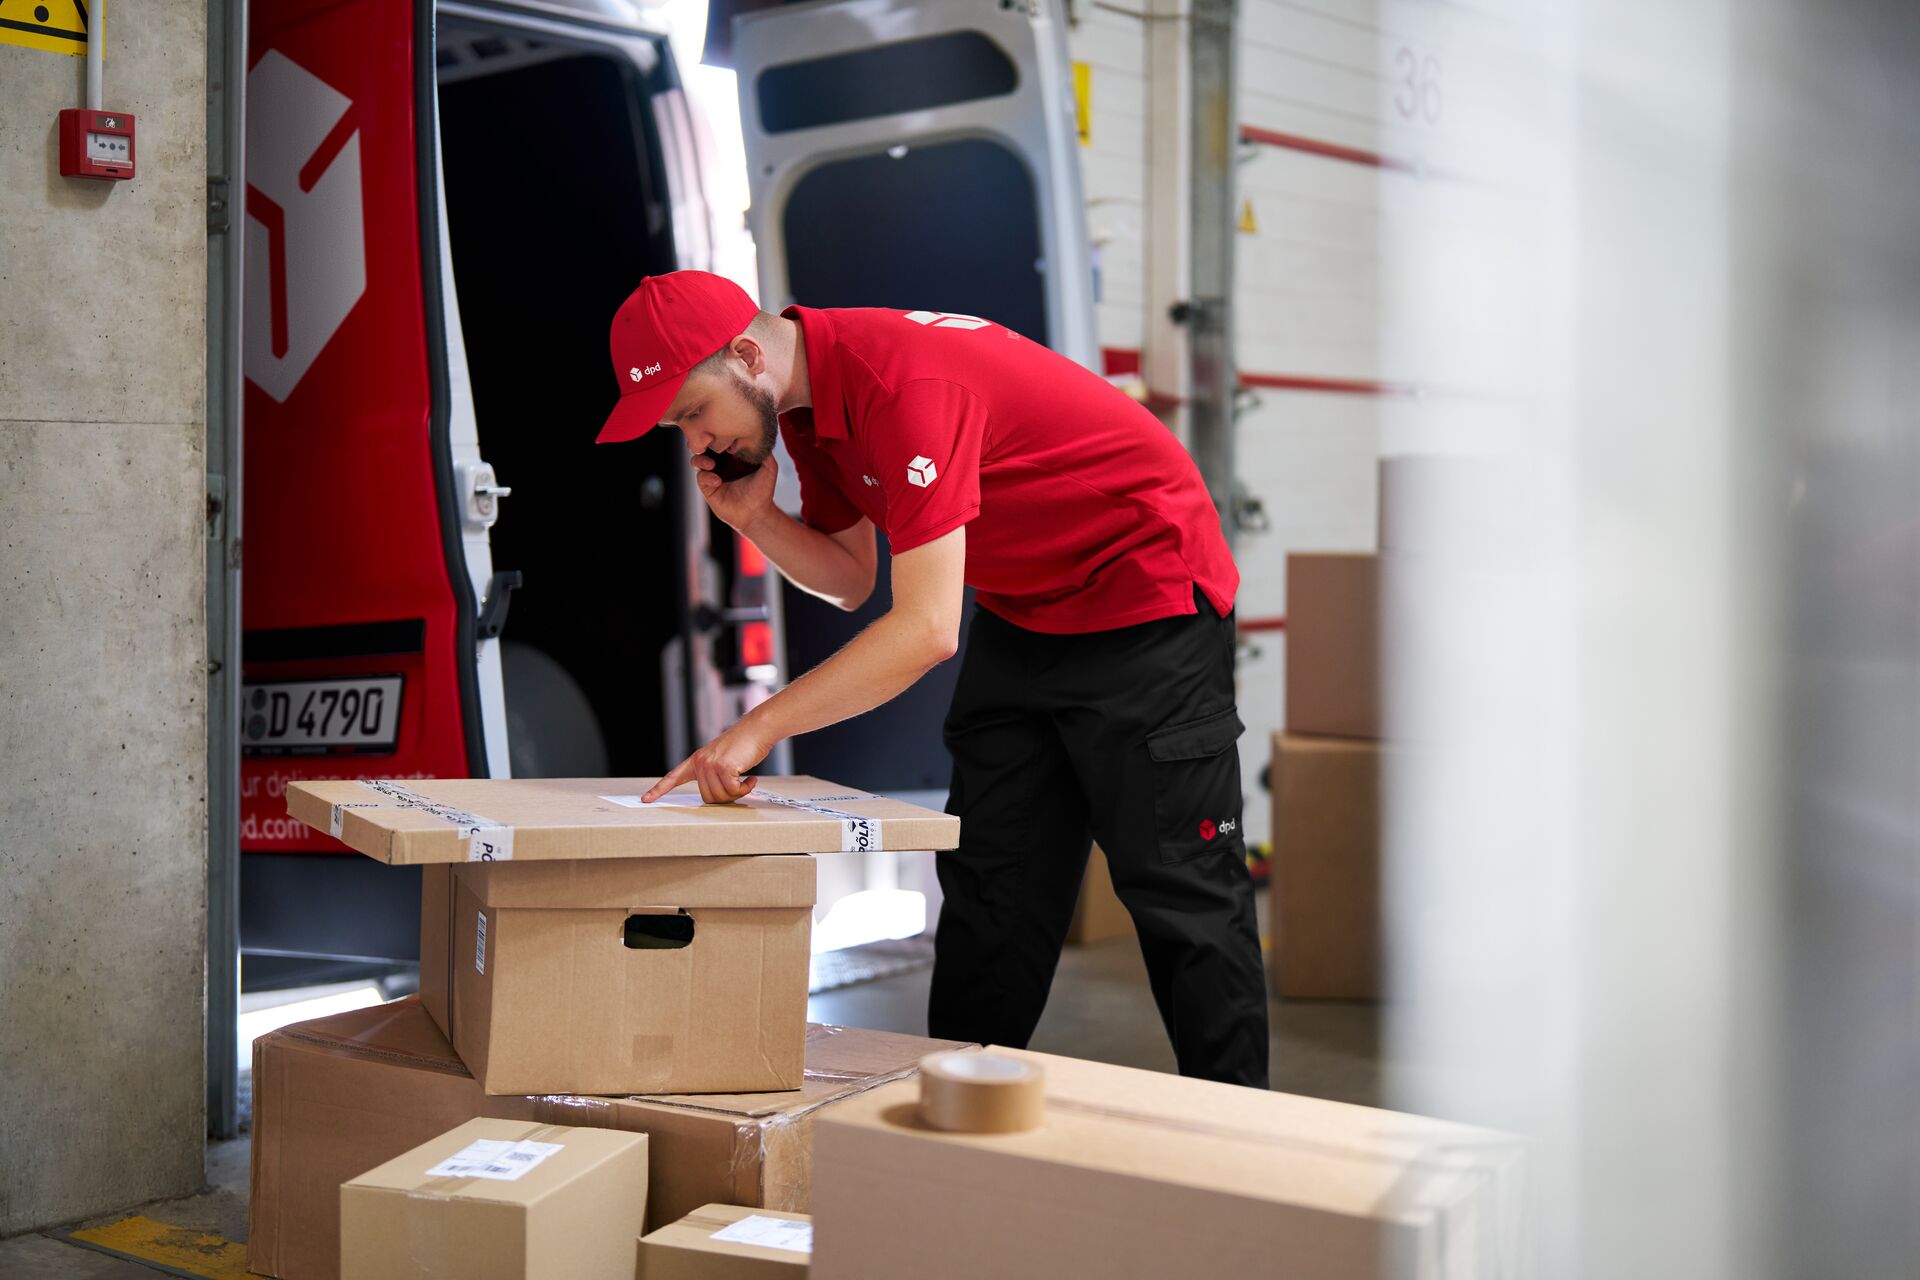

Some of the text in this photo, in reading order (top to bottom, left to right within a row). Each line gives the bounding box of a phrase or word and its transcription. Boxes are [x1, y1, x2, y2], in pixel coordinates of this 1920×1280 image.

[644, 362, 661, 375] dpd
[268, 687, 384, 738] D 4790
[1219, 818, 1235, 834] dpd
